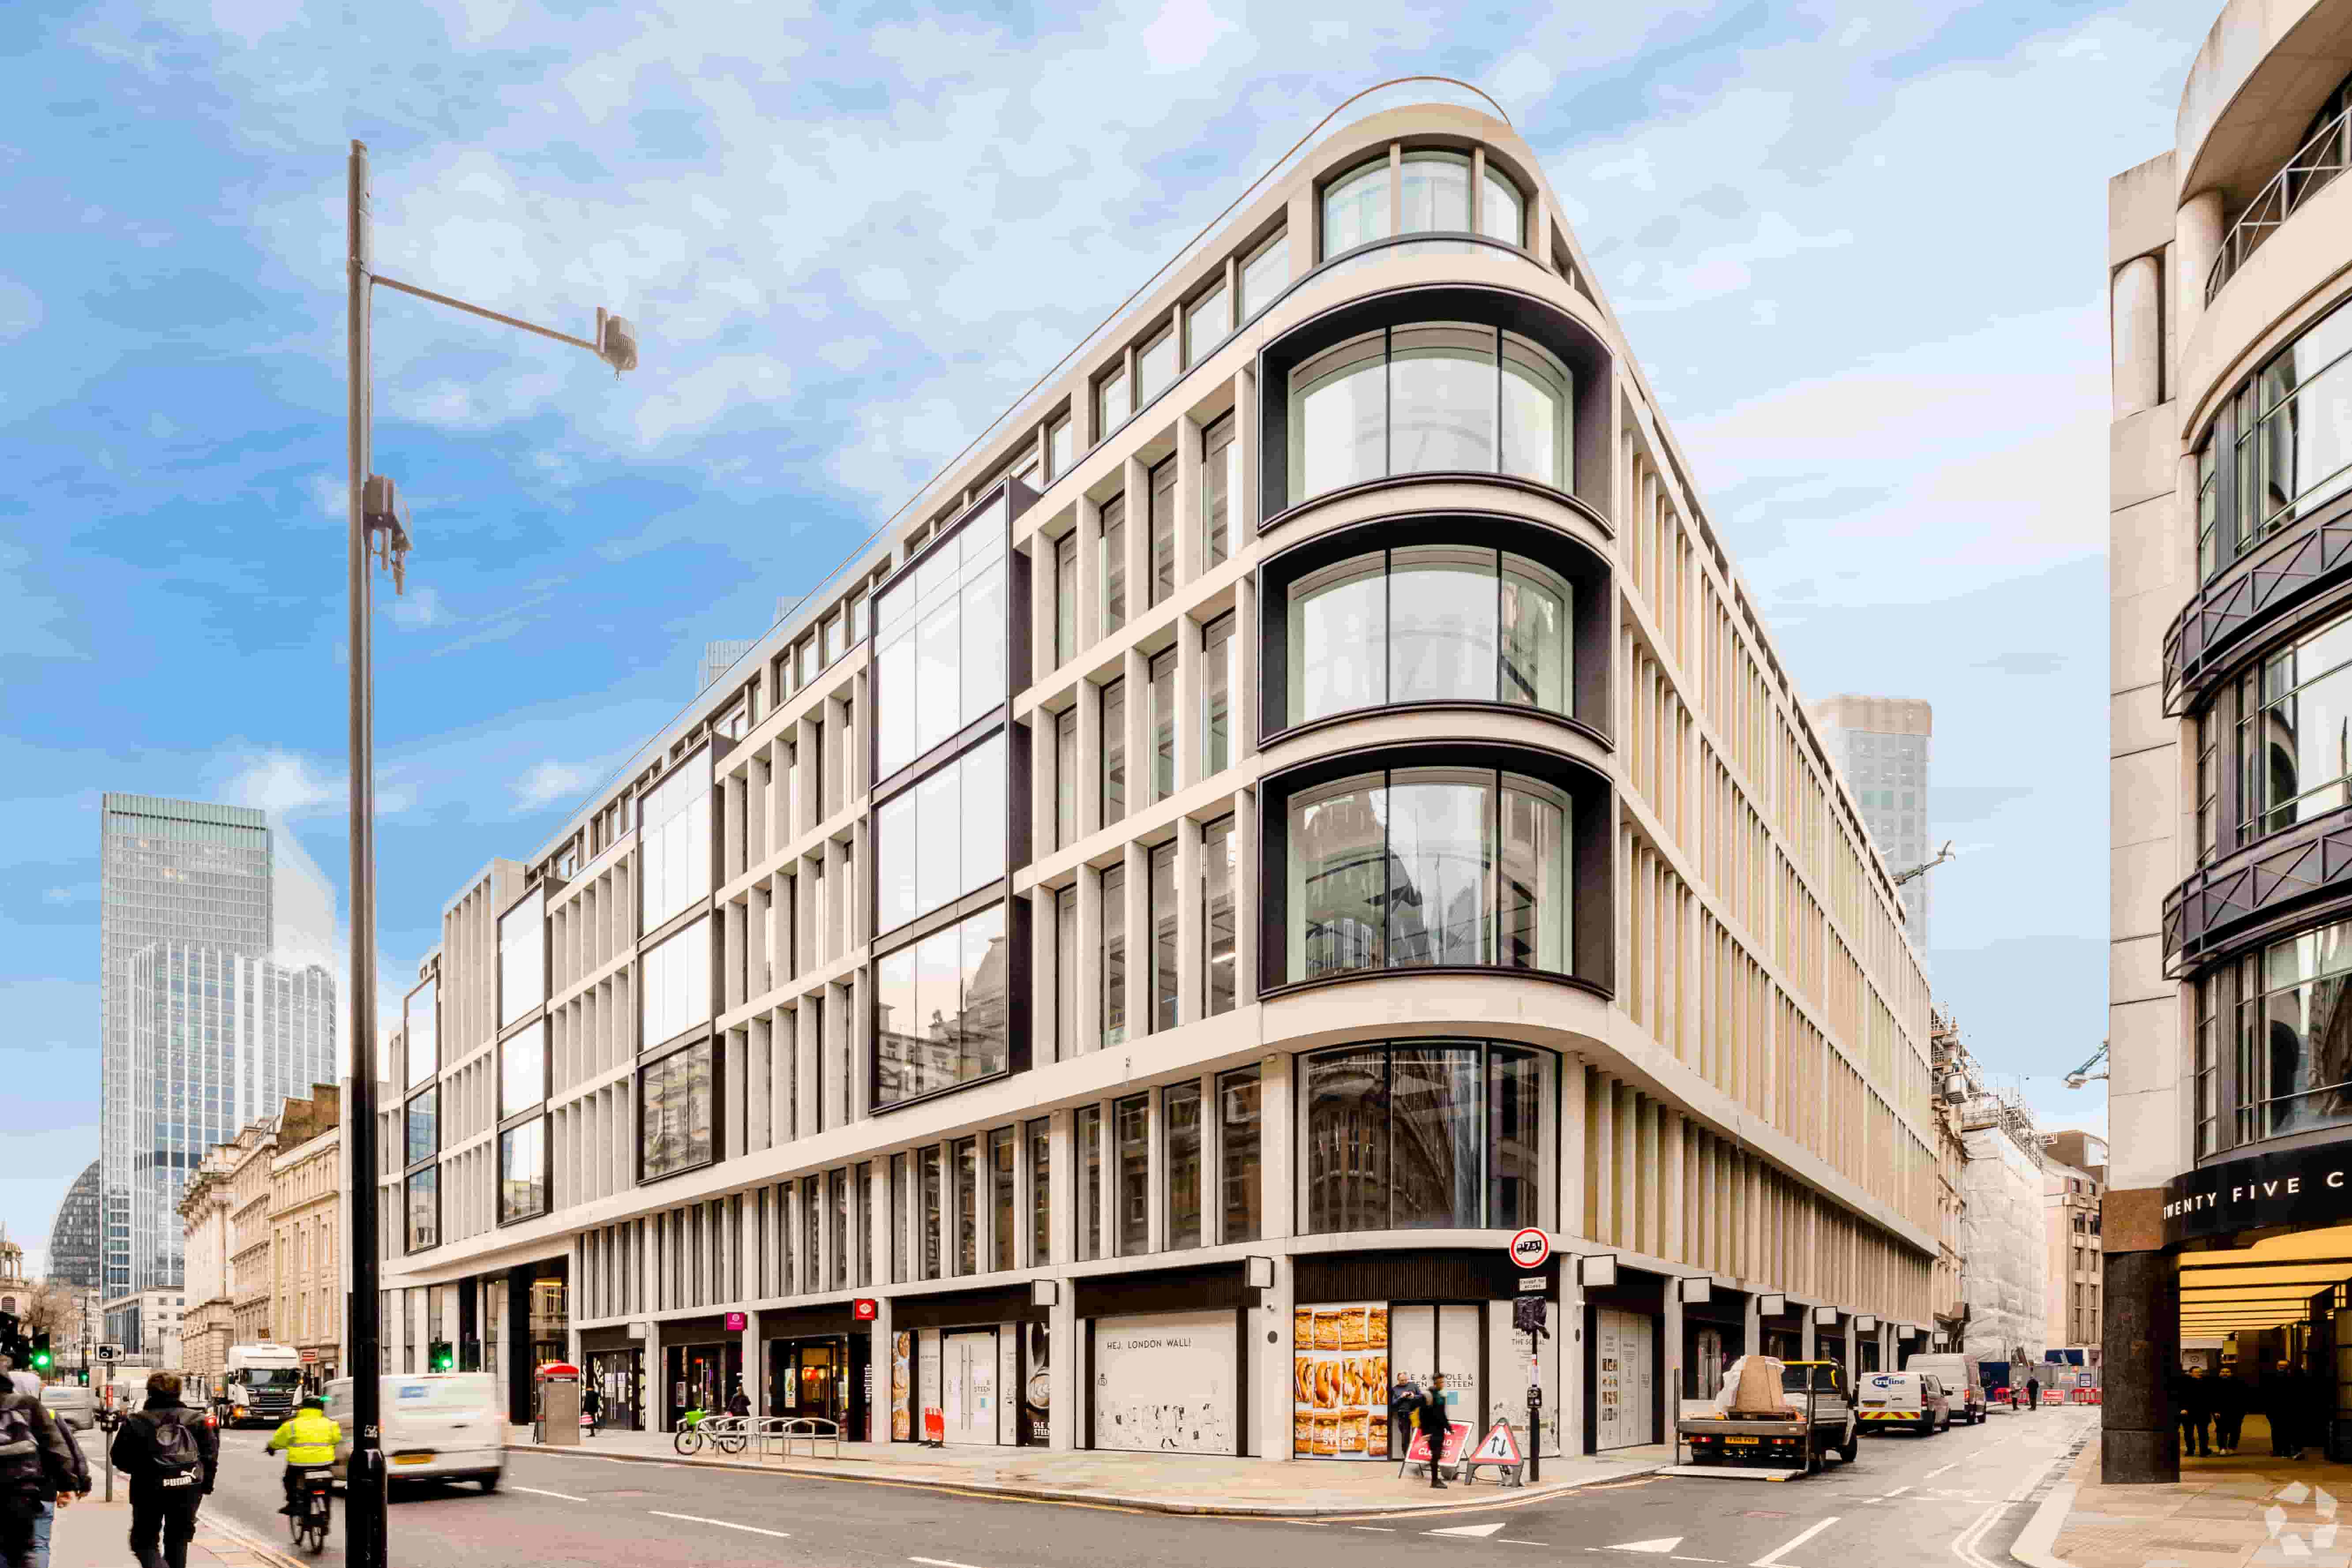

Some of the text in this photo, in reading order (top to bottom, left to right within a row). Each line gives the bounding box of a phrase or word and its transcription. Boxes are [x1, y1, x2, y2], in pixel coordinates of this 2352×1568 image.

[2163, 1192, 2217, 1220] TWENTY
[2232, 1177, 2300, 1202] FIVE
[1128, 1340, 1162, 1349] LONDON
[1166, 1338, 1192, 1347] WALL!
[163, 1475, 192, 1487] PUMA
